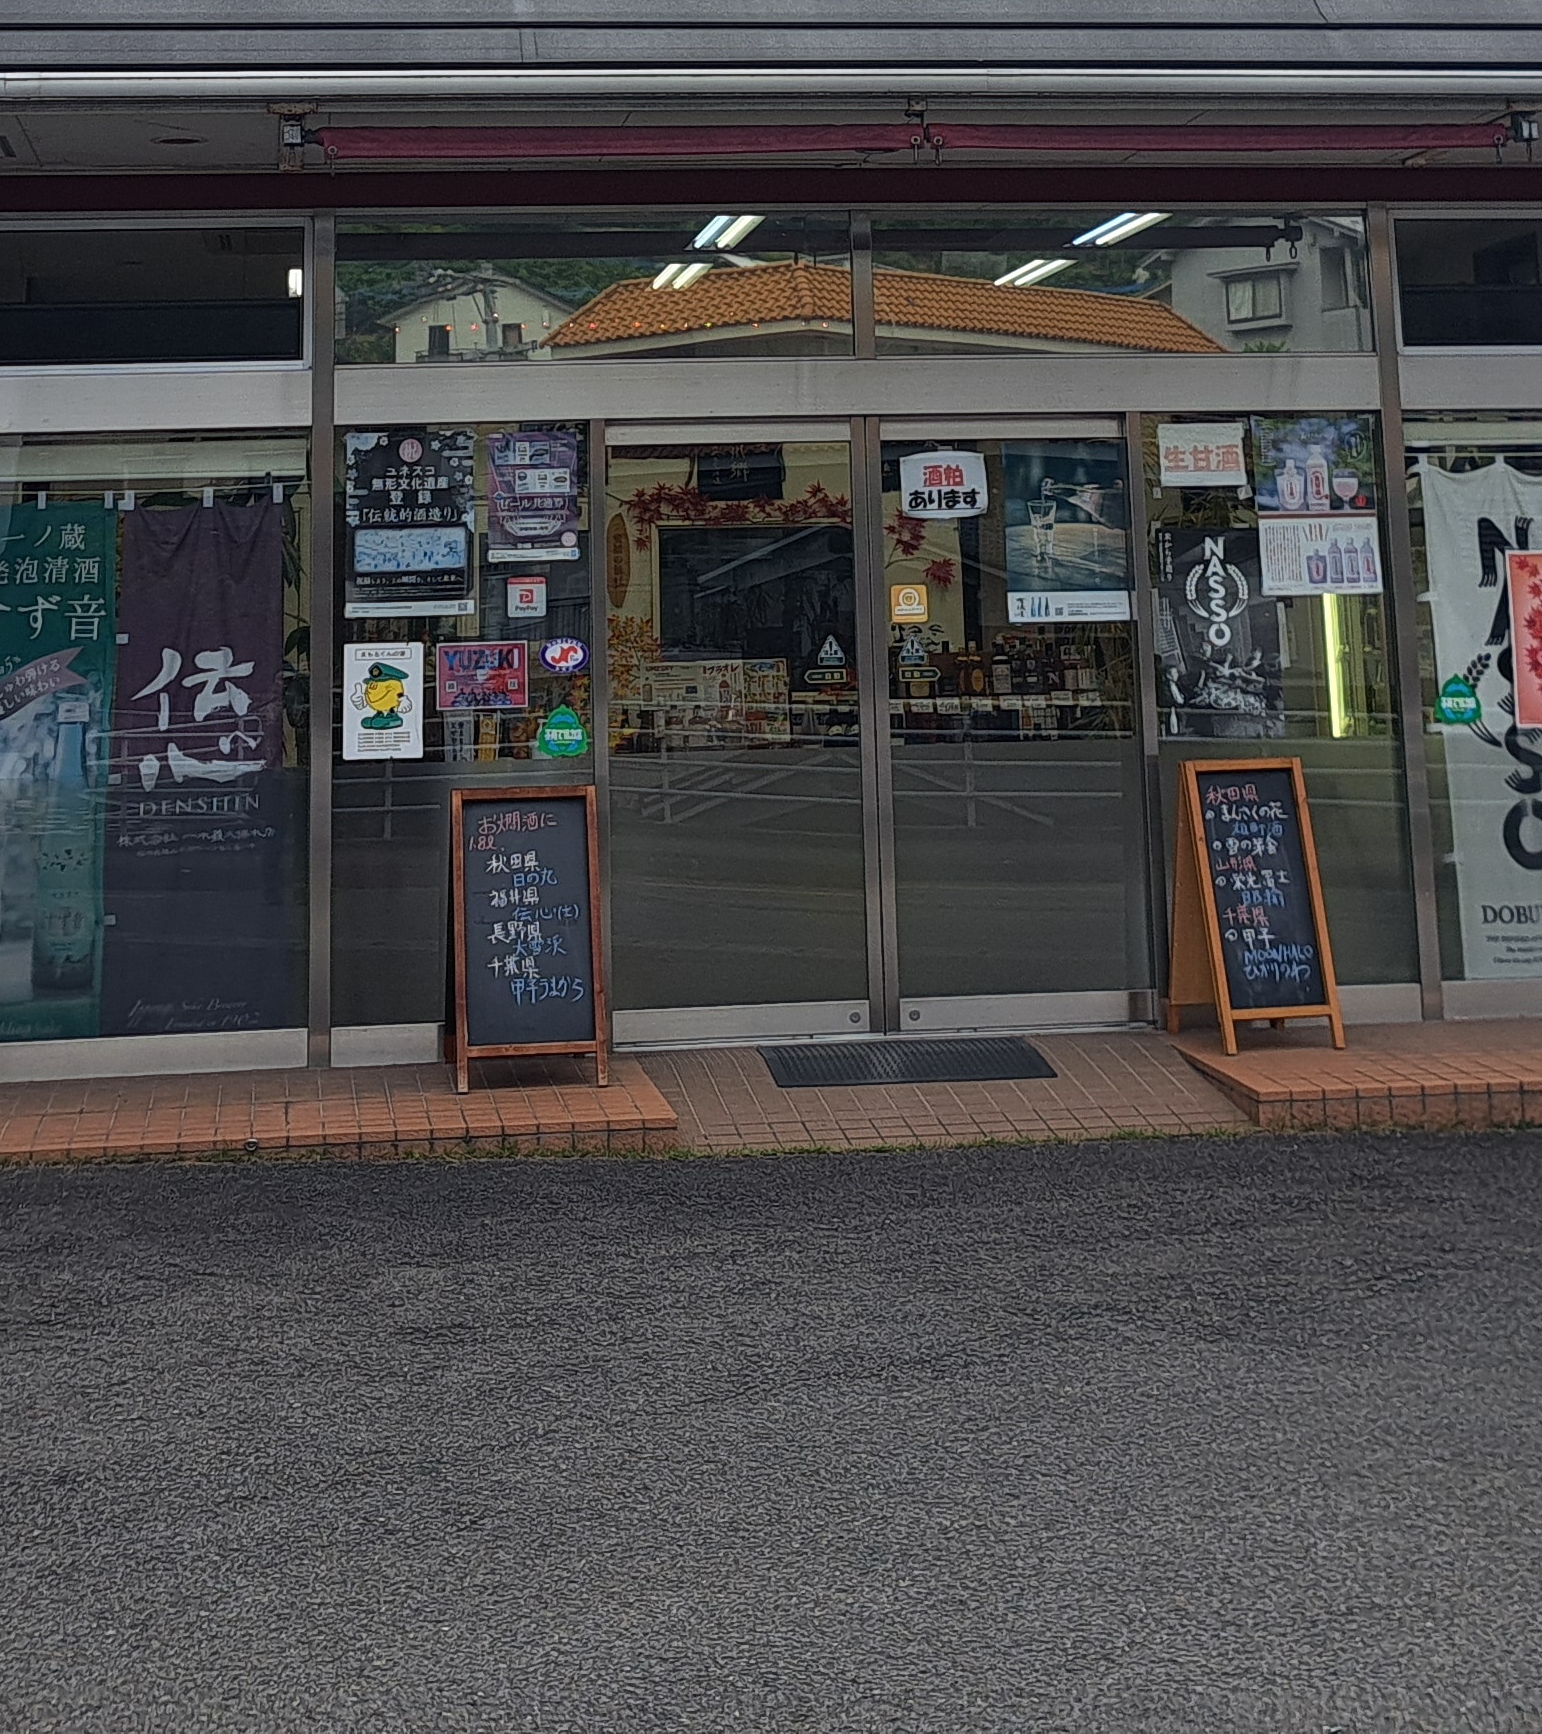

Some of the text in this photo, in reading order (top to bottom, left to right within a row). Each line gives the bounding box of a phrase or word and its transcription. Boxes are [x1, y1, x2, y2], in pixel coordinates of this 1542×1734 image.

[385, 465, 436, 477] ユネスコ
[1163, 444, 1240, 474] 生甘酒
[908, 487, 981, 509] あります
[0, 523, 86, 552] 一ノ蔵
[1203, 536, 1233, 647] NASSO
[514, 604, 539, 613] PayPay
[139, 793, 259, 817] DENSHIN
[1206, 783, 1260, 806] 秋田県
[477, 810, 558, 835] お燗酒に
[485, 850, 541, 875] 秋田県
[513, 868, 558, 888] 日の丸
[489, 886, 540, 908] 福井県
[487, 920, 542, 945] 長野県
[487, 954, 541, 980] 千葉県
